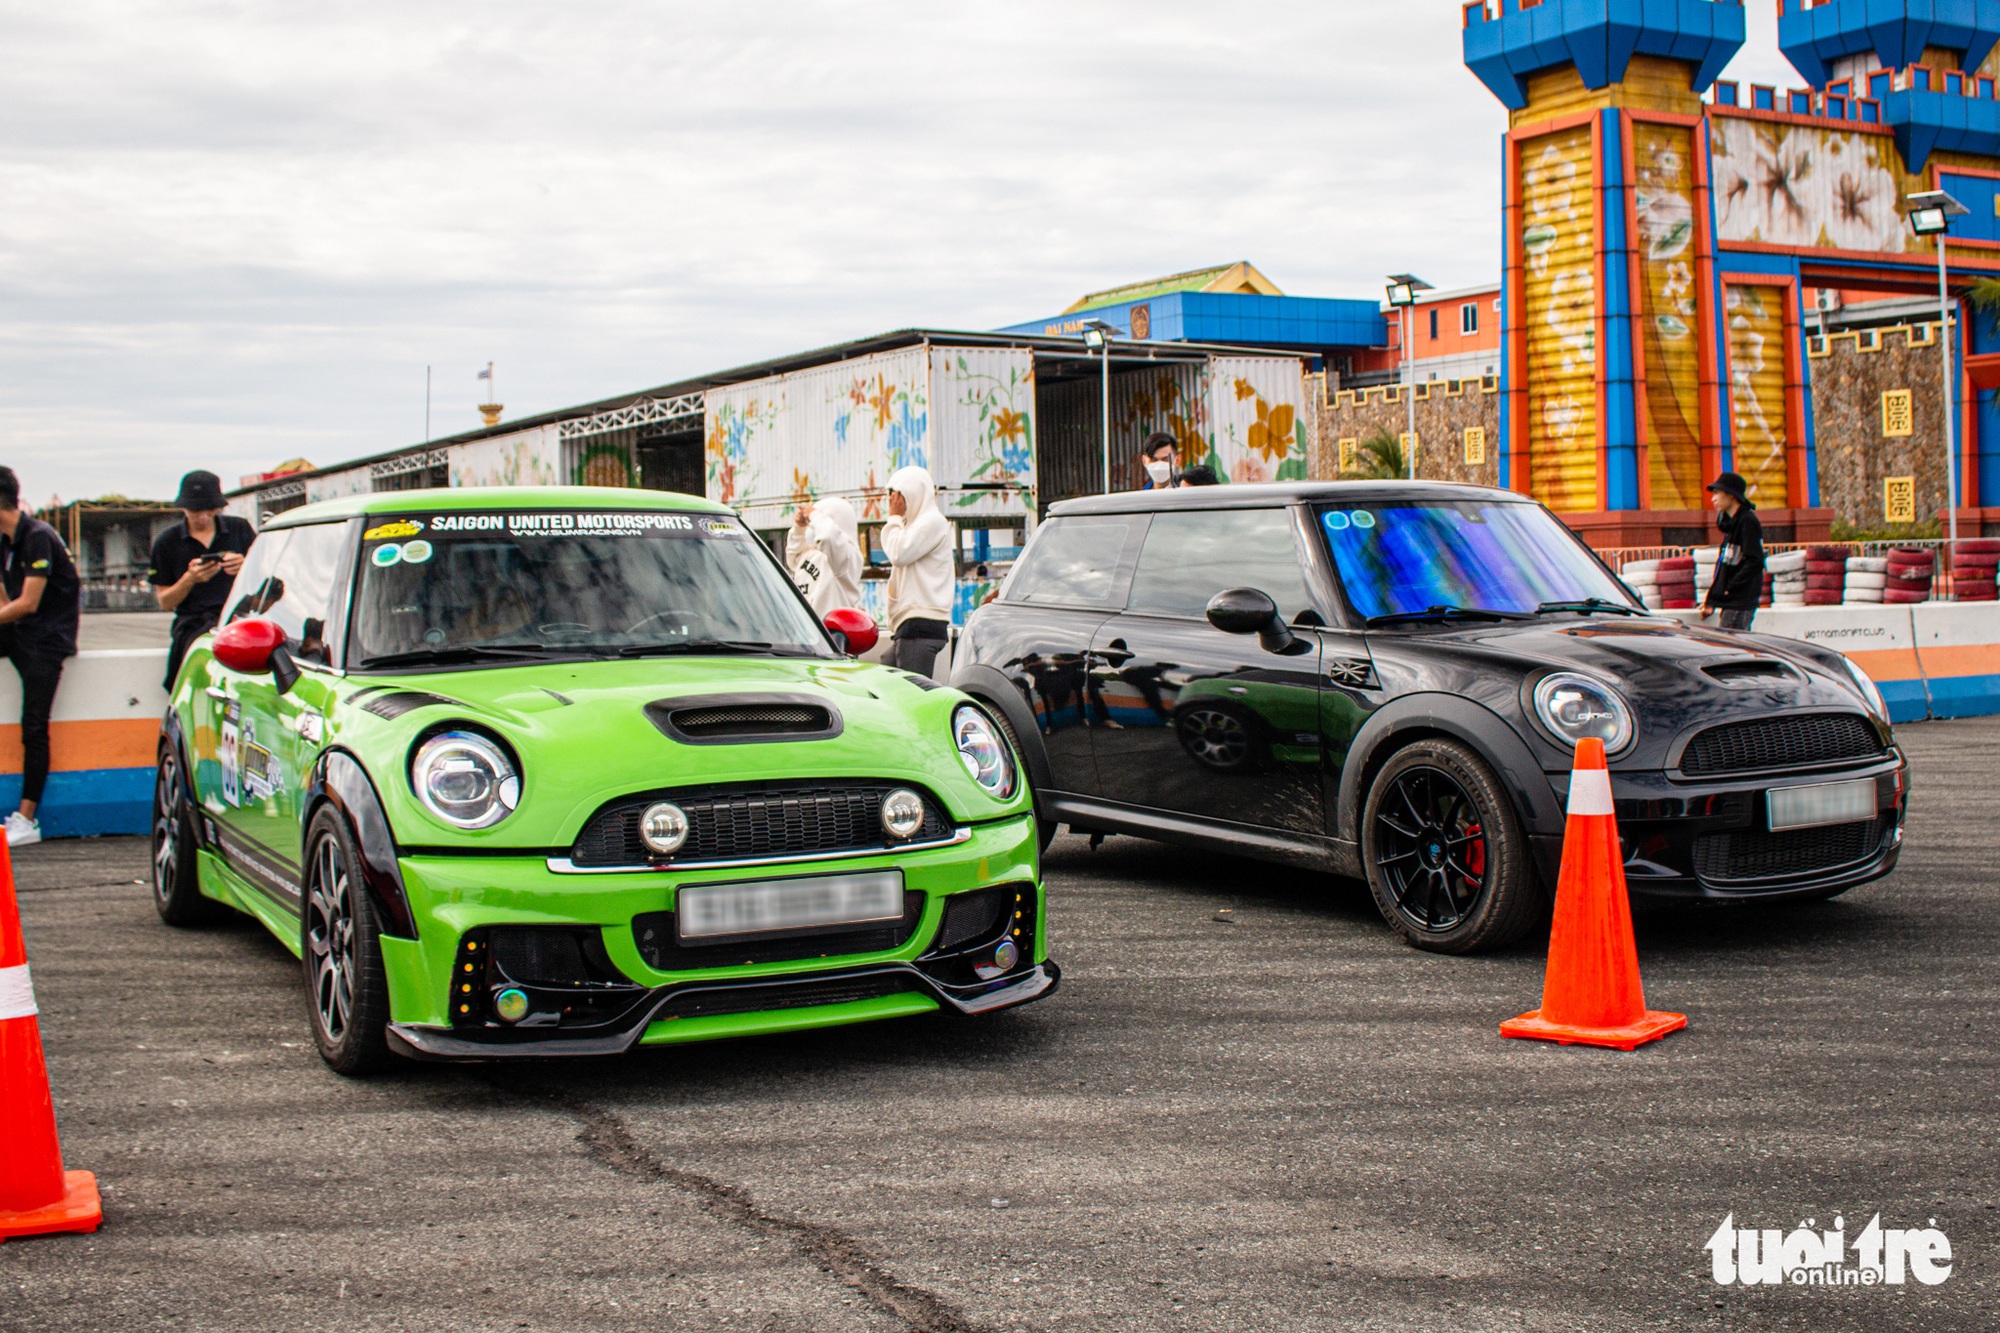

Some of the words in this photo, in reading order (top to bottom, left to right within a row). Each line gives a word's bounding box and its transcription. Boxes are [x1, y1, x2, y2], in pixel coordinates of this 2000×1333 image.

[430, 515, 504, 531] SAIGON
[508, 514, 574, 530] UNITED
[576, 514, 693, 531] MOTORSPORTS
[509, 527, 642, 538] WWW.SUMRACING.VN
